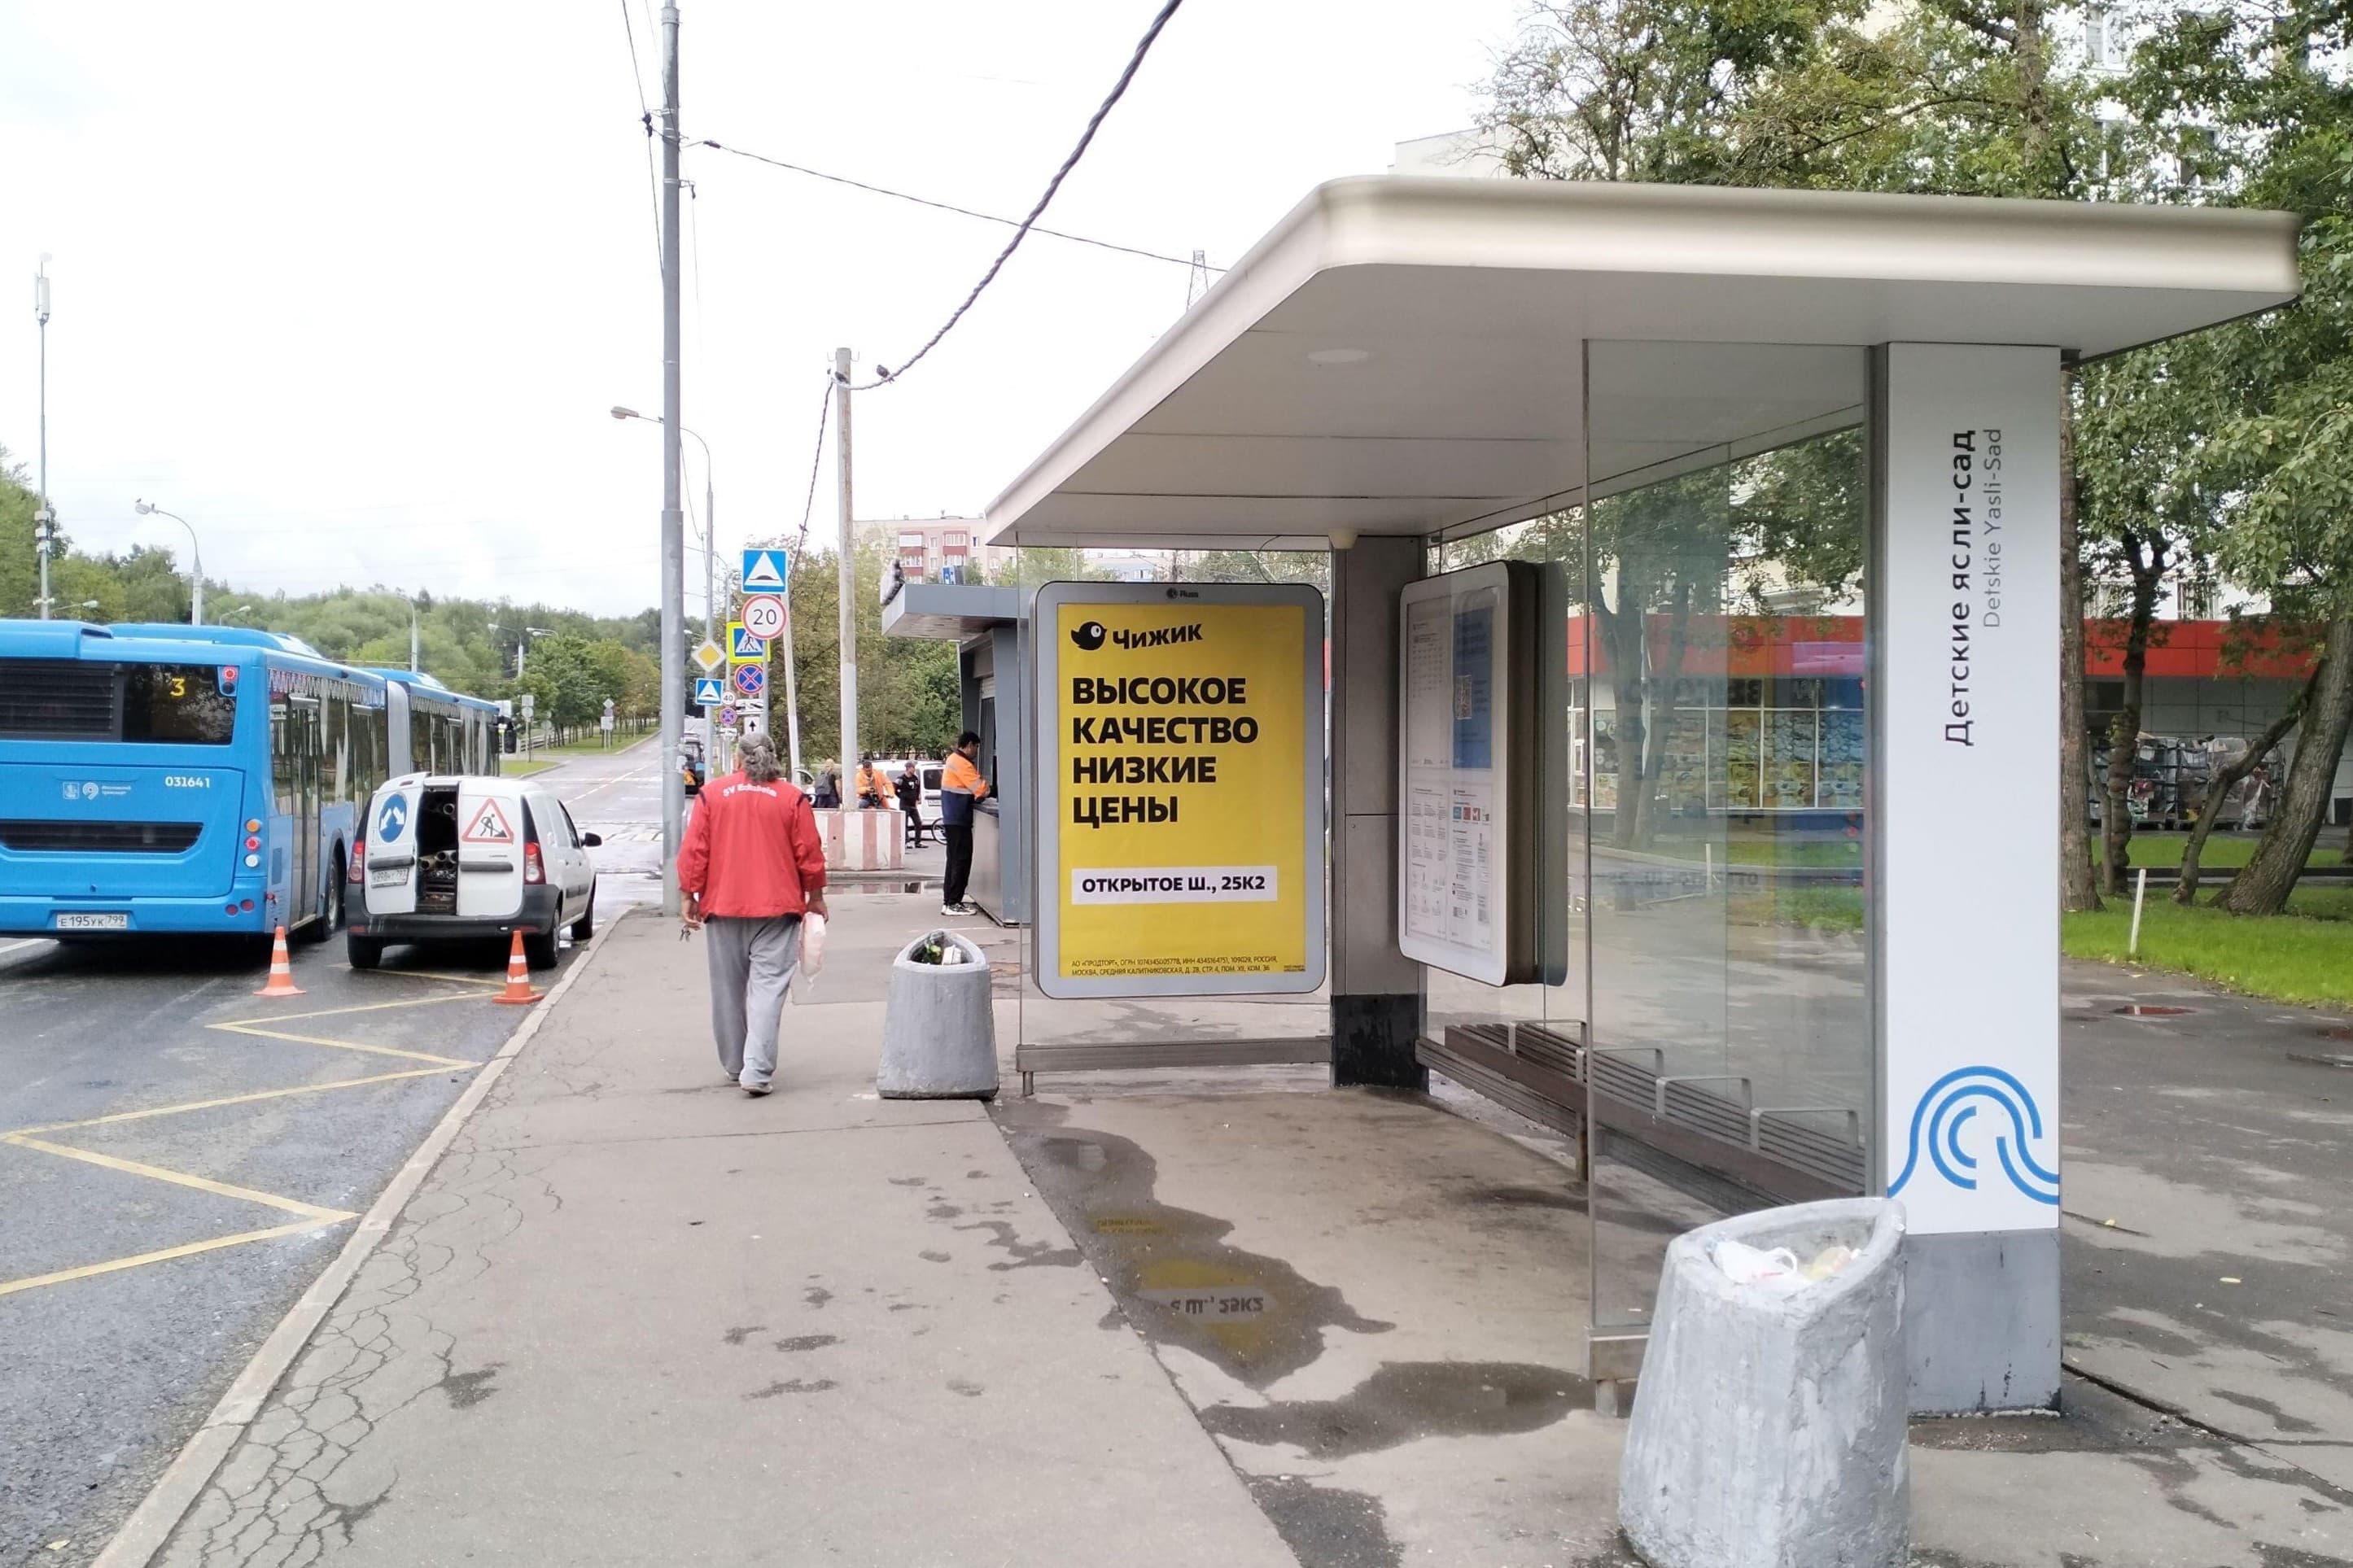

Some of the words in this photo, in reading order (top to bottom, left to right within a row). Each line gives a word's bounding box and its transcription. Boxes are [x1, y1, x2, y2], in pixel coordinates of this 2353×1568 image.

[1983, 429, 2001, 535] Yasli-Sad
[1953, 430, 1975, 590] ясли-сад
[1983, 542, 2001, 627] Detskie
[753, 609, 777, 625] 20
[1113, 623, 1203, 650] Чижик
[170, 678, 185, 697] 3
[1945, 601, 1974, 746] Детские
[723, 694, 733, 702] 40
[1073, 677, 1246, 705] ВЫСОКОЕ
[1073, 716, 1258, 744] КАЧЕСТВО
[165, 776, 211, 788] 031641
[1073, 756, 1216, 784] НИЗКИЕ
[1073, 796, 1178, 828] ЦЕНЫ
[1082, 877, 1183, 893] ОТКРЫТОЕ
[1187, 876, 1217, 894] Ш.,
[1221, 876, 1266, 890] 25К2
